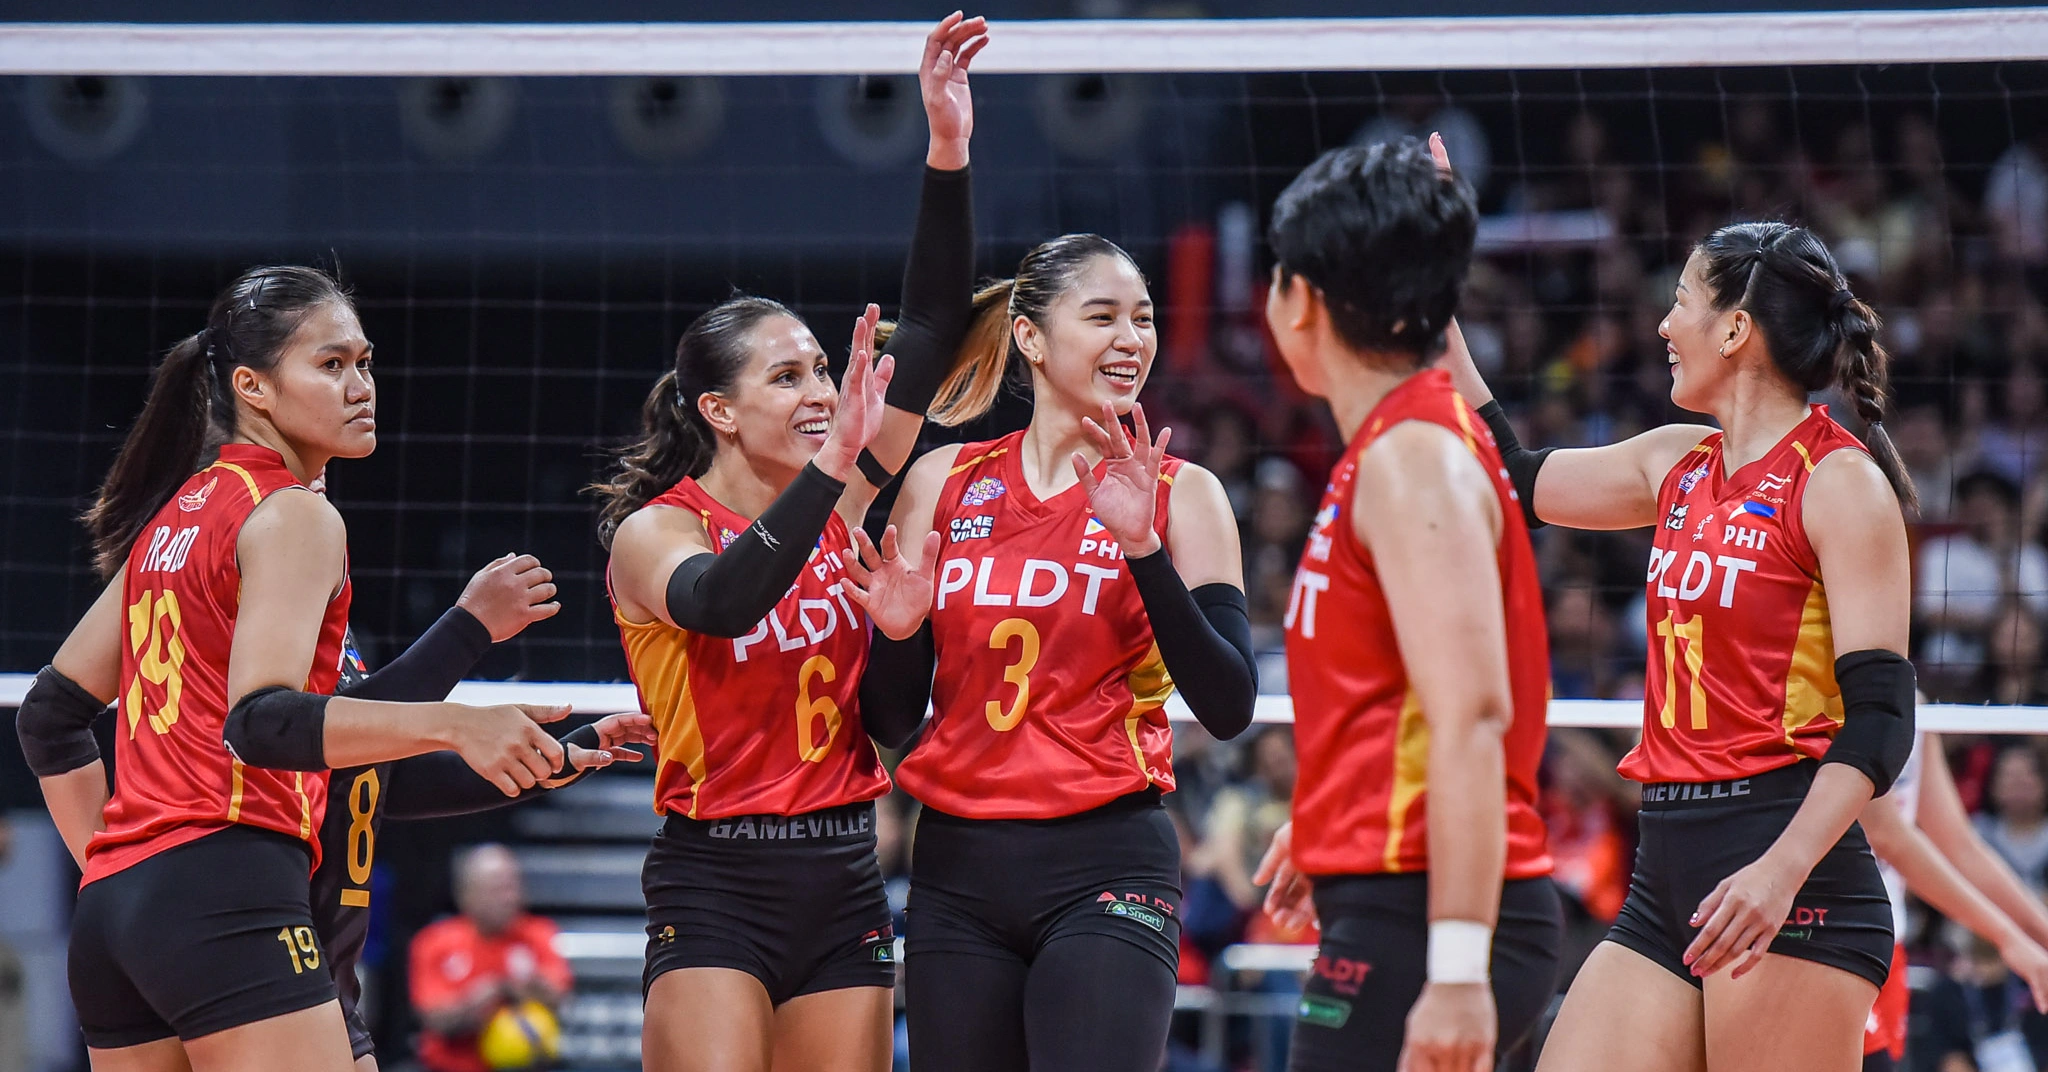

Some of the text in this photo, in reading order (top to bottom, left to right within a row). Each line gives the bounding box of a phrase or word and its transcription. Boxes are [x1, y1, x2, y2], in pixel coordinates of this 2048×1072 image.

[1722, 524, 1768, 551] PHI
[937, 556, 1120, 616] PLDT
[1646, 546, 1758, 609] PLDT
[733, 583, 859, 663] PLDT
[126, 589, 186, 741] 19
[985, 618, 1040, 732] 3
[1657, 610, 1708, 731] 11
[795, 655, 843, 763] 6
[347, 767, 380, 885] 8
[708, 811, 870, 841] GAMEVILLE
[277, 925, 320, 974] 19
[1127, 906, 1161, 928] Smart
